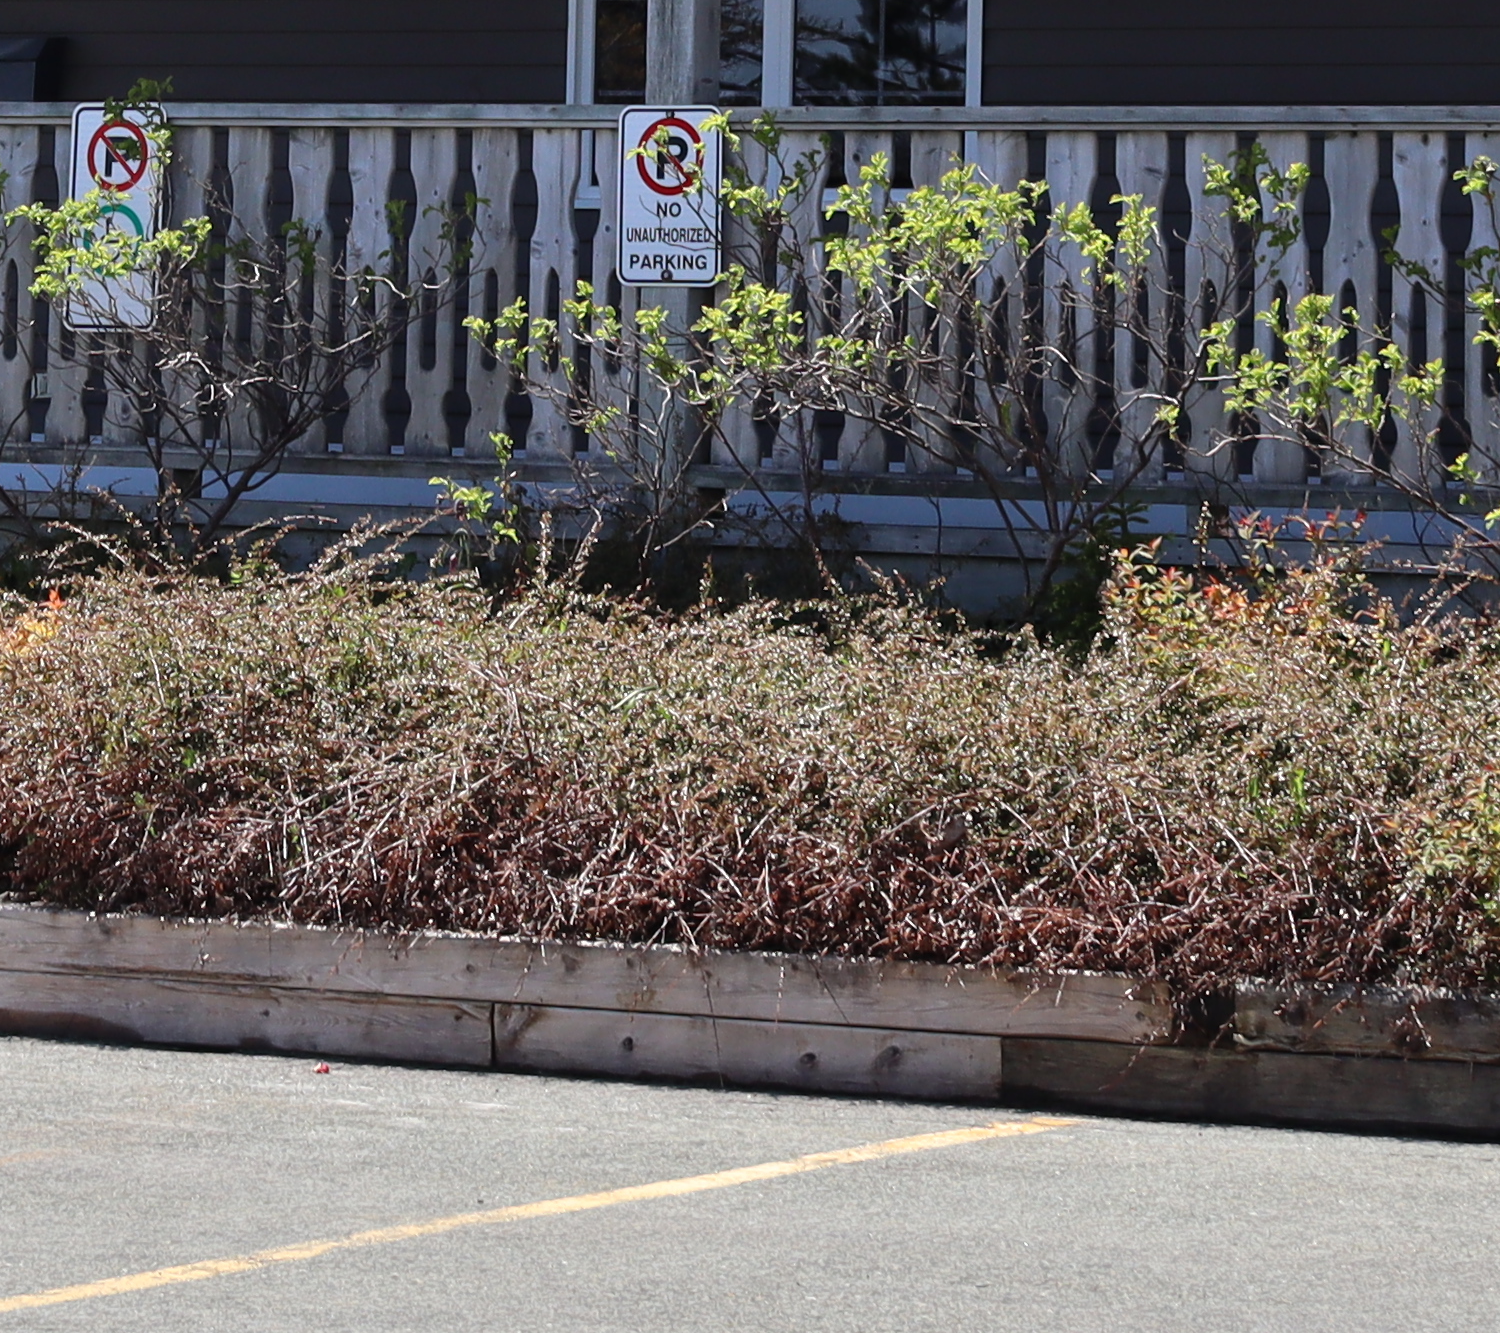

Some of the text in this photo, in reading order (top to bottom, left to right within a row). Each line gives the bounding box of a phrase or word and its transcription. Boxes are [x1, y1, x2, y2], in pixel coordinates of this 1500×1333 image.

[656, 201, 682, 218] NO
[626, 227, 711, 243] UNAUTHORIZED
[629, 253, 708, 270] PARKING
